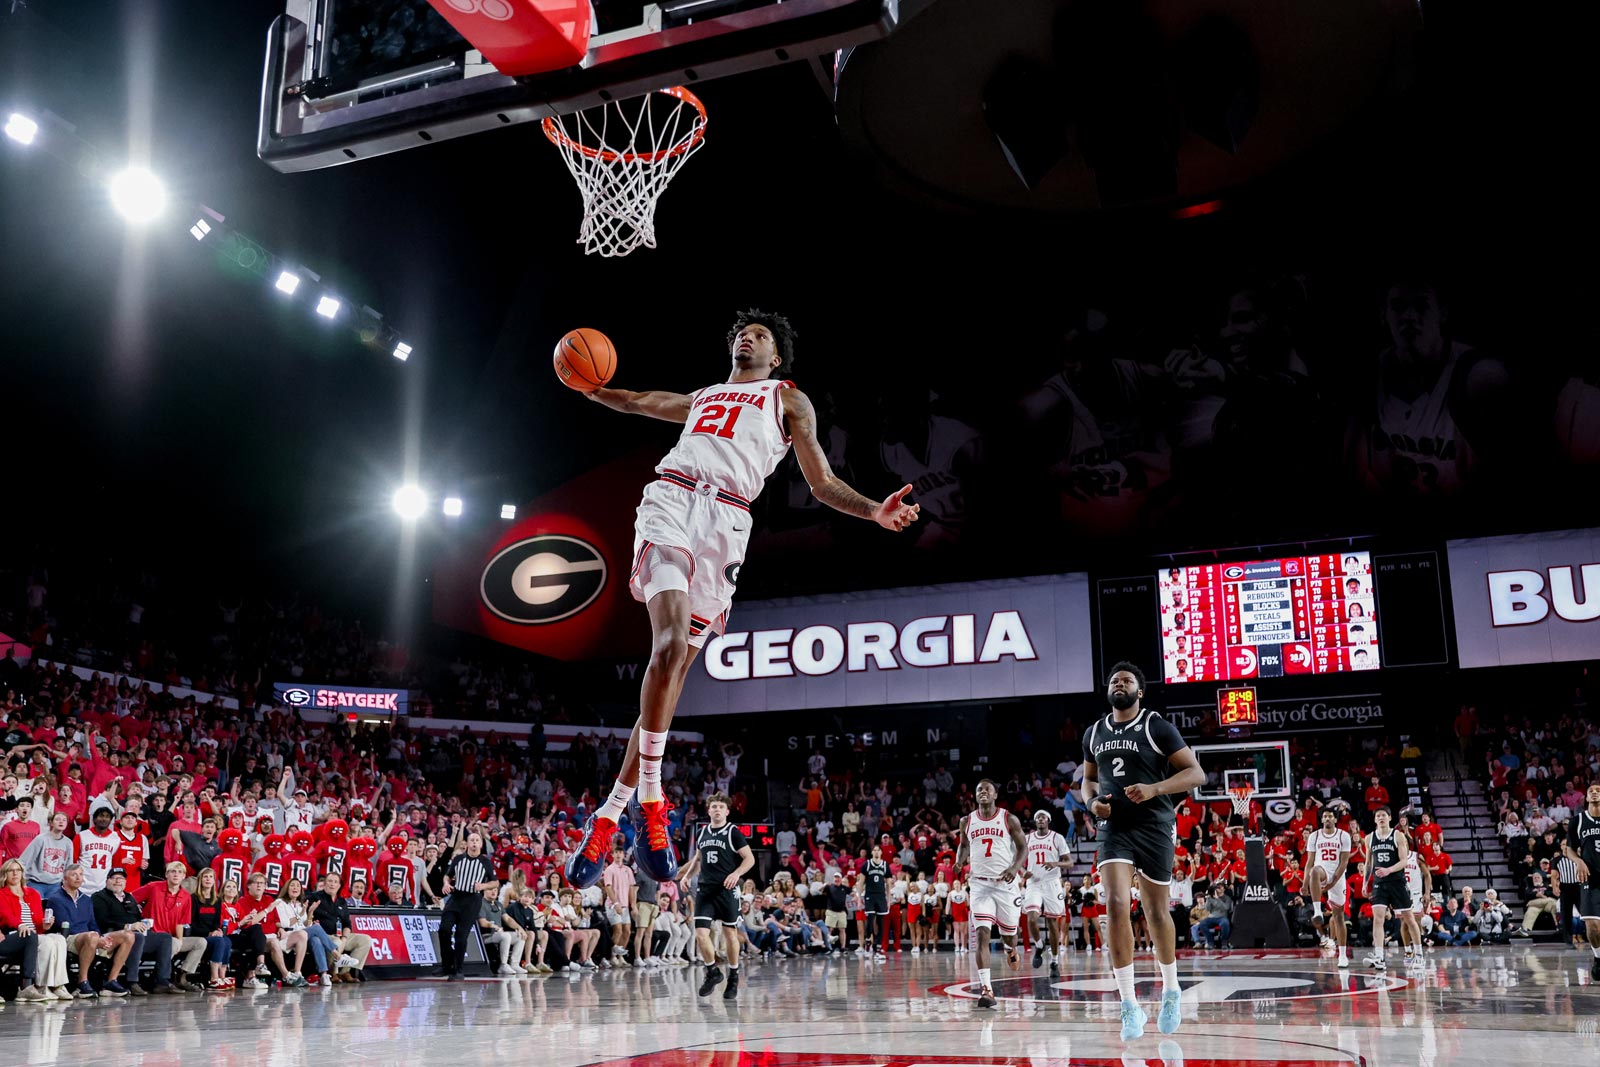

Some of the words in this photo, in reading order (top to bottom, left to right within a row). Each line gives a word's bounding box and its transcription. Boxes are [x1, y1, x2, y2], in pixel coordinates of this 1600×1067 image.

[693, 392, 766, 411] GEORGIA
[691, 404, 743, 440] 21
[1253, 582, 1276, 590] FOULS
[1246, 592, 1284, 600] REBOUNDS
[1487, 563, 1600, 628] BU
[1253, 602, 1280, 610] BLOCKS
[1254, 612, 1281, 620] STEALS
[1253, 623, 1282, 631] ASSISTS
[1247, 633, 1290, 642] TURNOVERS
[704, 610, 1039, 681] GEORGIA
[1261, 656, 1279, 665] FG%
[316, 689, 398, 711] SEATGEEK
[1228, 690, 1253, 703] 8:48
[1166, 711, 1200, 728] The
[1292, 703, 1308, 721] of
[1311, 700, 1383, 724] Georgia
[1226, 702, 1251, 722] 27
[788, 728, 940, 750] STEGEMN
[1095, 740, 1140, 757] CAROLINA
[1112, 757, 1126, 777] 2
[970, 827, 1004, 839] GEORGIA
[85, 842, 113, 853] GEORGIA
[700, 840, 726, 850] CAROLINA
[762, 837, 774, 846] 54
[981, 838, 993, 857] 7
[1372, 843, 1395, 852] CAROLINA
[1029, 844, 1052, 852] GEORGIA
[706, 850, 718, 863] 15
[1035, 852, 1045, 864] 11
[1321, 849, 1337, 861] 25
[1377, 852, 1390, 862] 55
[91, 854, 107, 869] 14
[266, 862, 282, 890] E
[1245, 885, 1269, 897] Alfa
[355, 917, 394, 931] GEORGIA
[404, 918, 424, 930] 8:49
[371, 938, 393, 961] 64
